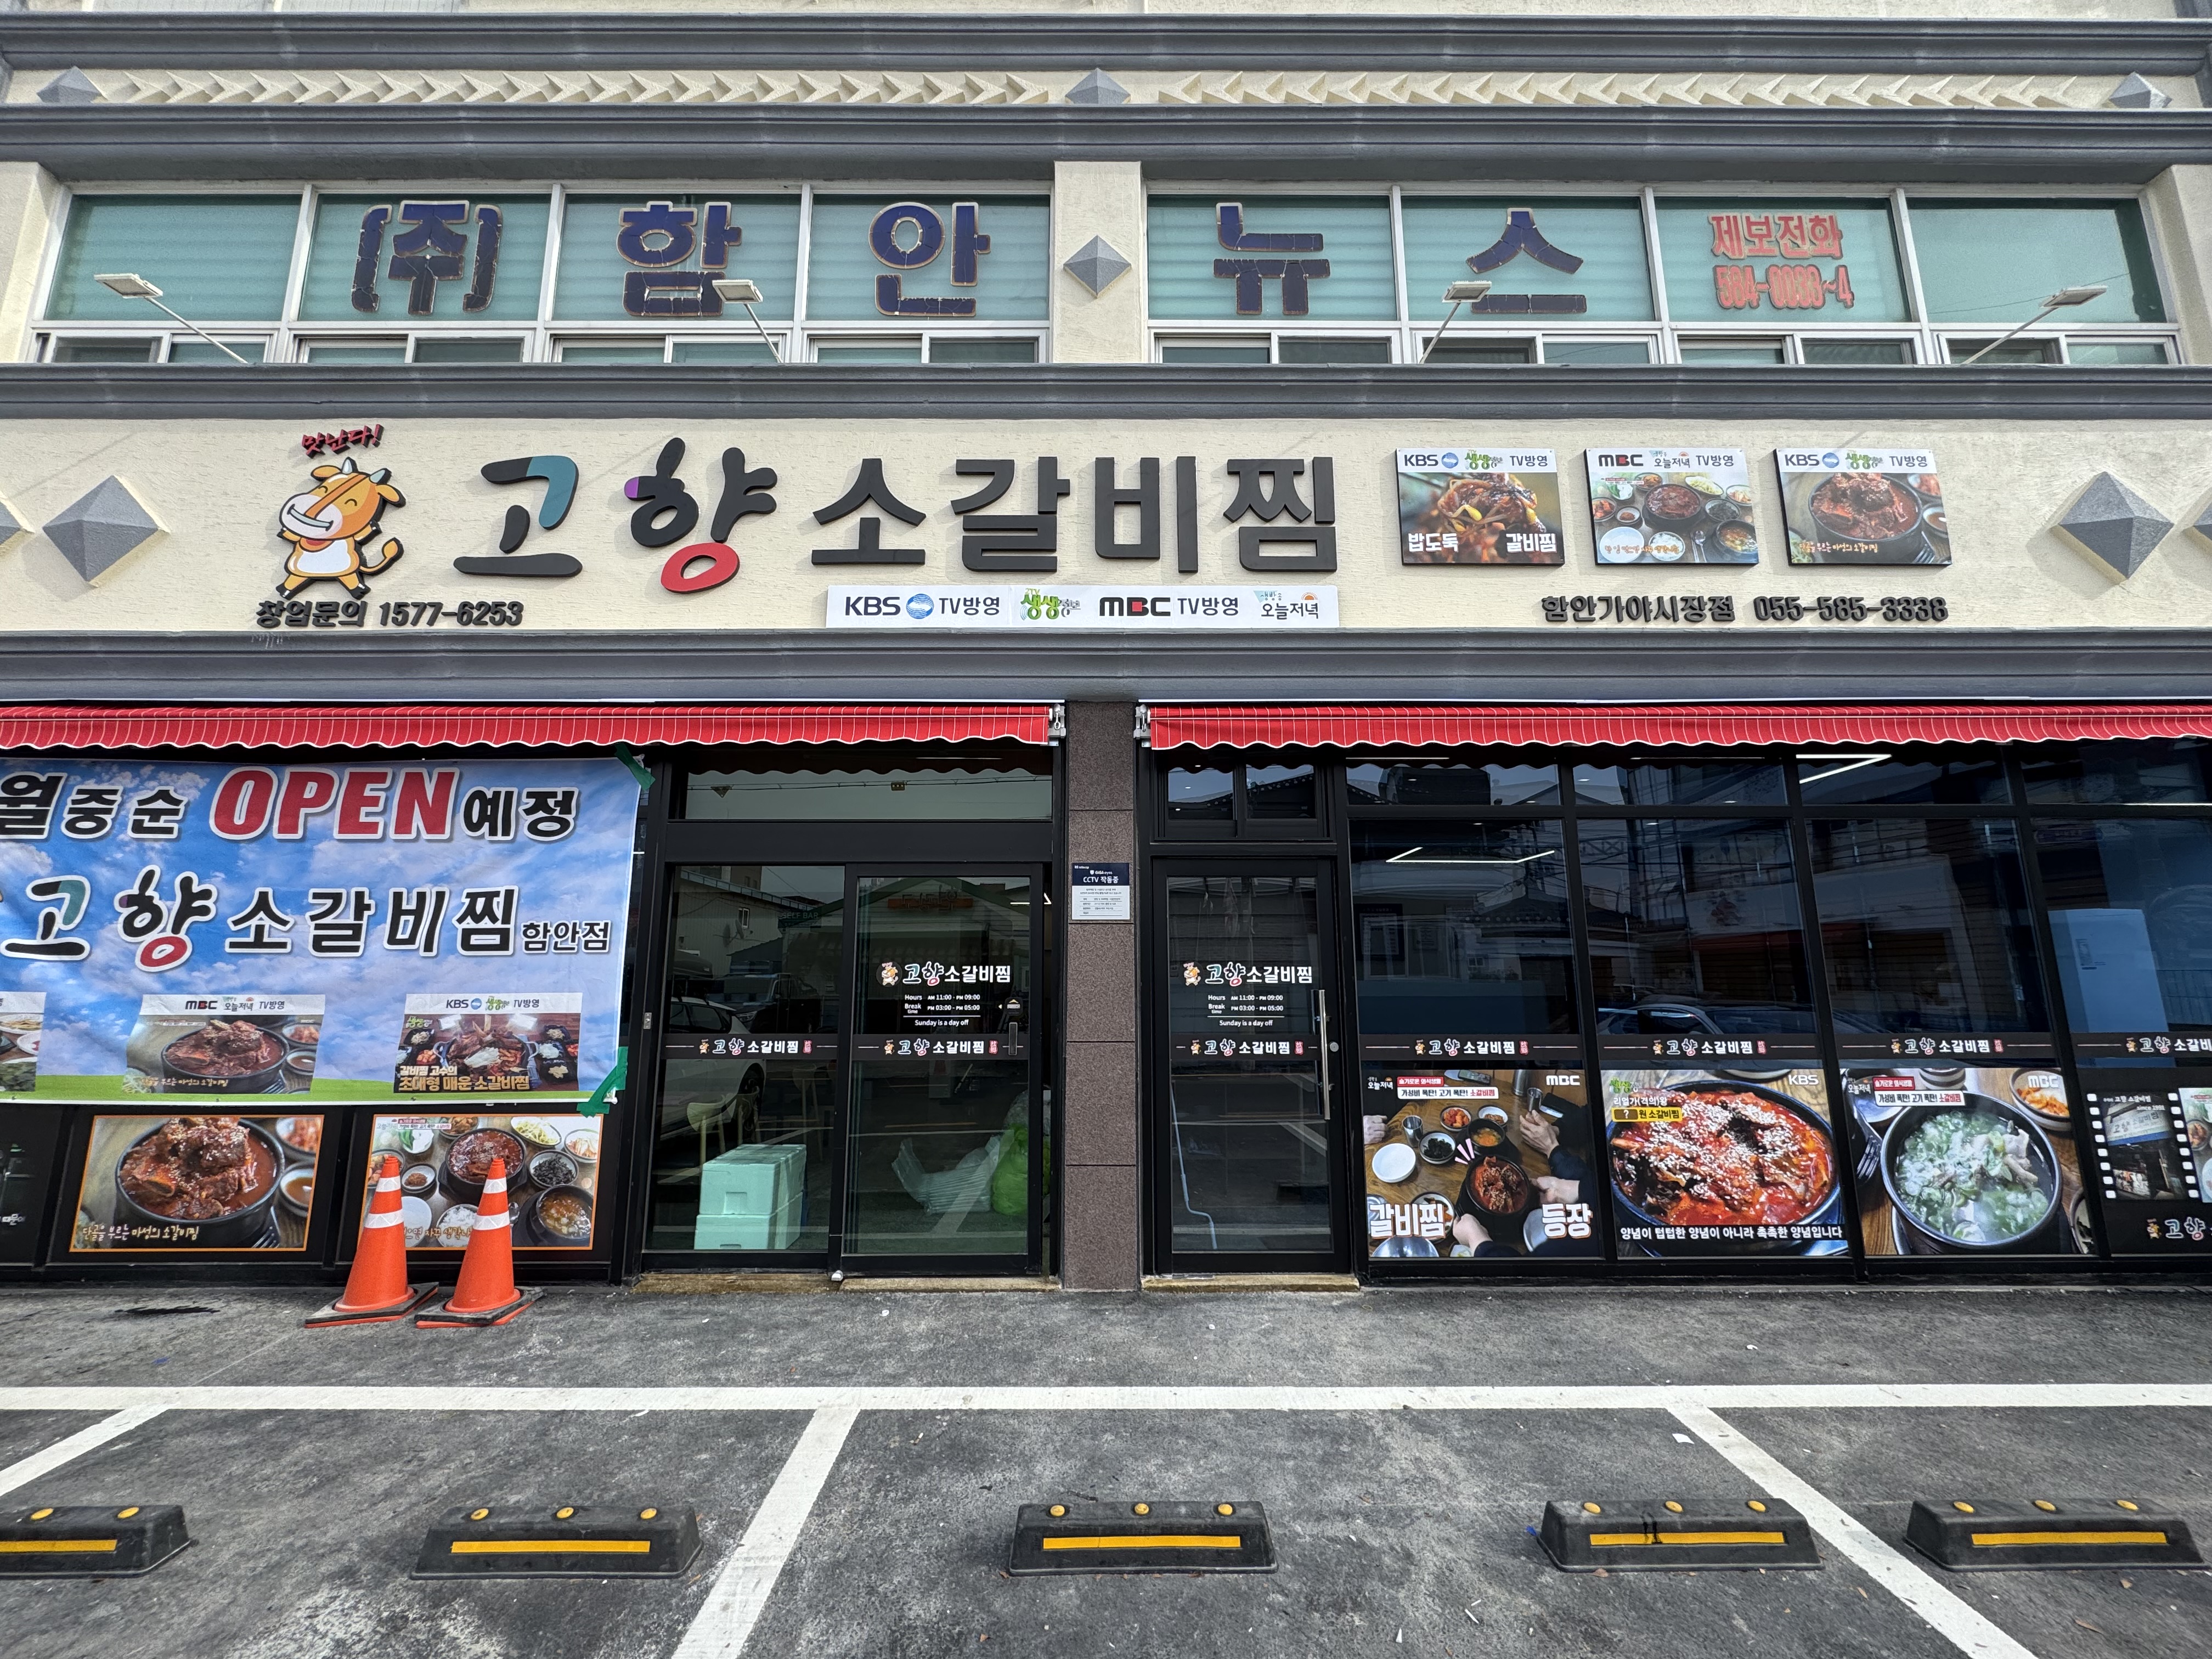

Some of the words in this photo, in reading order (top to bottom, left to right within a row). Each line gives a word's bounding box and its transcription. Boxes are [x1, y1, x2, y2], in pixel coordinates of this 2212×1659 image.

[1709, 212, 1843, 259] 제보전화
[302, 424, 385, 459] 맛난다!
[1404, 454, 1438, 466] KBS
[1510, 455, 1548, 466] TV방영
[1598, 455, 1644, 466] MBC
[1654, 458, 1690, 469] 오늘저녁
[1696, 455, 1734, 466] TV방영
[1785, 454, 1820, 466] KBS
[1889, 456, 1928, 467] TV방영
[1408, 533, 1459, 552] 밥도둑
[1506, 533, 1556, 552] 갈비찜
[845, 596, 900, 616] KBS
[939, 597, 1000, 616] TV방영
[1099, 597, 1171, 616] MBC
[1178, 597, 1239, 616] TV방영
[1261, 602, 1319, 619] 오늘저녁
[1542, 595, 1735, 622] 함안가야시장점
[1754, 596, 1949, 621] 055-585-3338
[256, 601, 368, 628] 창업문의
[380, 601, 524, 627] 1577-6253
[521, 919, 611, 955] 함안점
[185, 1001, 218, 1009] MBC
[224, 1002, 254, 1012] 오늘저녁
[259, 1001, 285, 1009] TV방영
[446, 1000, 469, 1008] KBS
[514, 999, 539, 1008] TV방영
[400, 1066, 428, 1075] 갈비찜
[431, 1066, 457, 1076] 고수의
[399, 1076, 440, 1091] 초대형
[443, 1076, 472, 1091] 매운
[474, 1076, 530, 1090] 소갈비찜
[1368, 1081, 1393, 1090] 오늘저녁
[1546, 1075, 1580, 1086] MBC
[1788, 1074, 1819, 1086] KBS
[2028, 1075, 2059, 1088] MBC
[1848, 1084, 1871, 1095] 오늘저녁
[1911, 1094, 1923, 1103] 고기
[1639, 1109, 1647, 1119] 원
[1649, 1109, 1679, 1119] 소갈비찜
[1369, 1204, 1446, 1238] 갈비찜
[1542, 1203, 1593, 1238] 등장
[83, 1224, 106, 1241] 단골을
[108, 1224, 129, 1240] 부르는
[132, 1225, 160, 1240] 마성의
[162, 1224, 199, 1241] 소갈비찜
[425, 1228, 441, 1238] 자꾸
[1621, 1227, 1652, 1239] 양념이
[1655, 1227, 1686, 1239] 텁텁한
[1689, 1227, 1720, 1239] 양념이
[1723, 1227, 1754, 1239] 아니라
[1757, 1226, 1788, 1239] 촉촉한
[1791, 1226, 1842, 1238] 양념입니다
